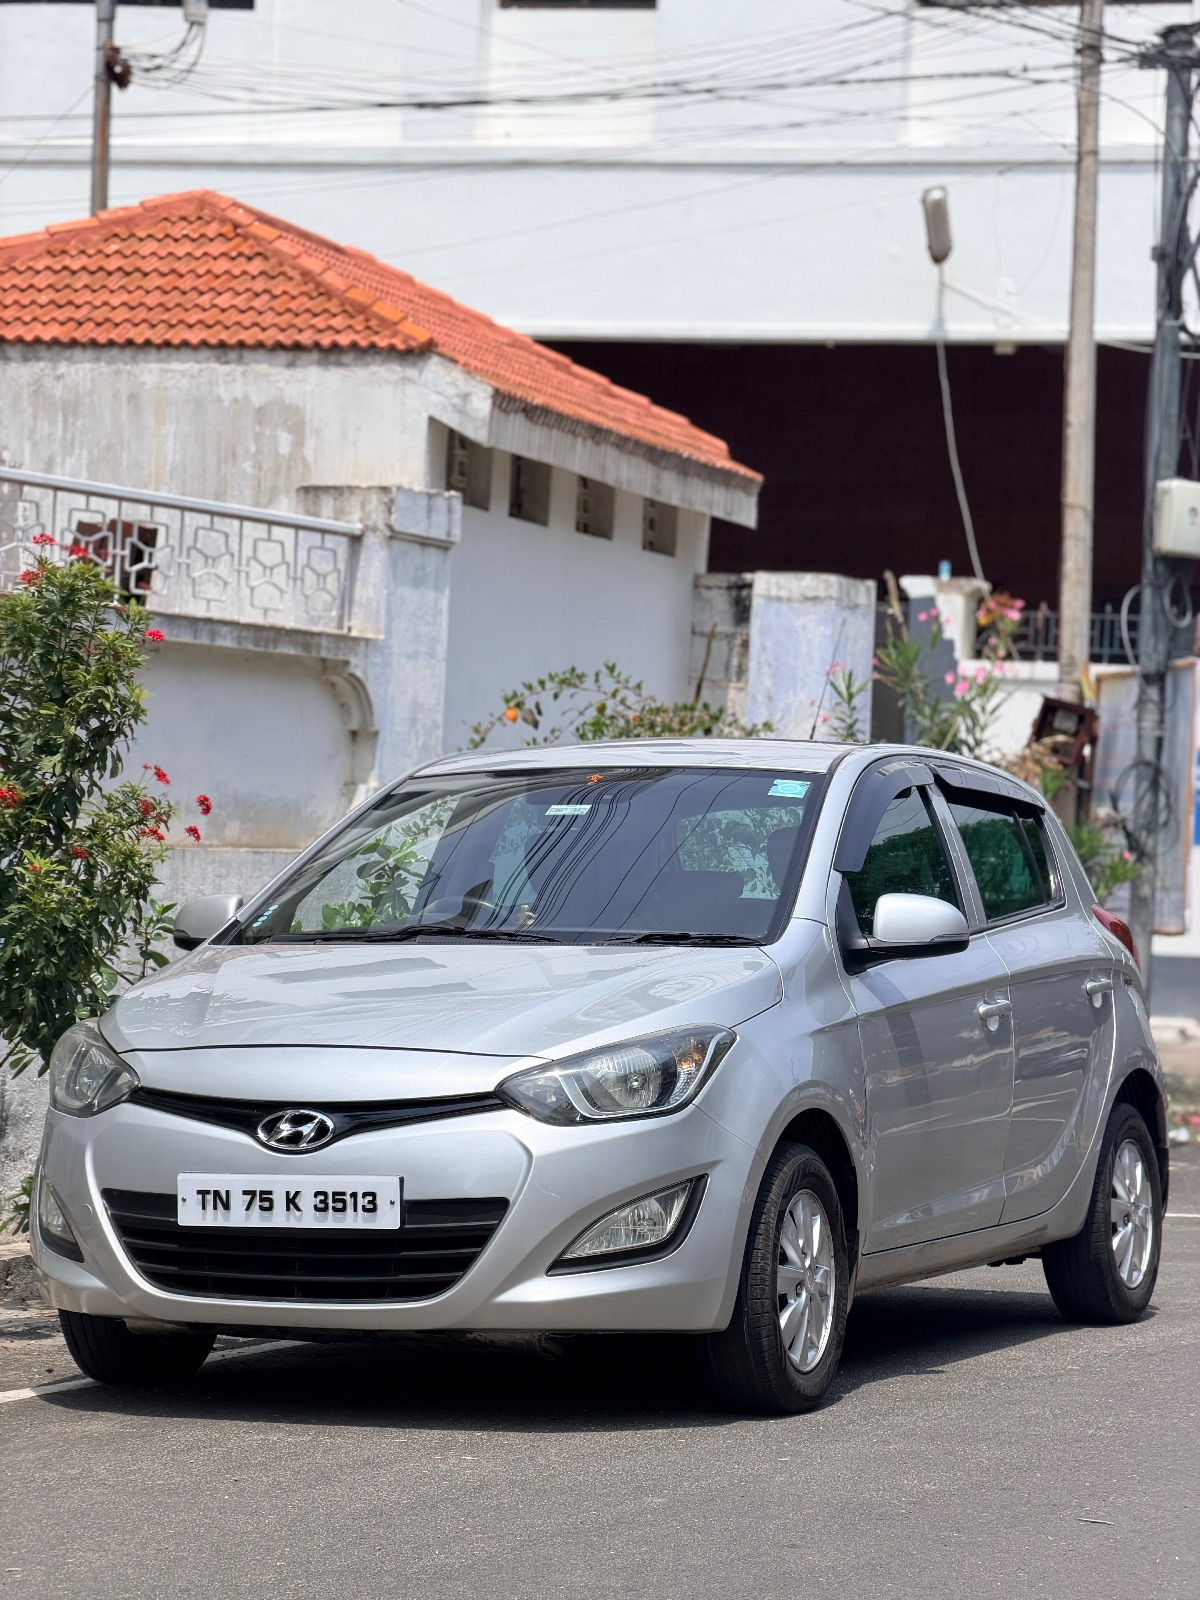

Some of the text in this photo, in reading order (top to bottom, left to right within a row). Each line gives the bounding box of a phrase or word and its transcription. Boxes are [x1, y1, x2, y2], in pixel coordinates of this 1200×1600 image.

[196, 1189, 378, 1213] TN 75 K 3513
